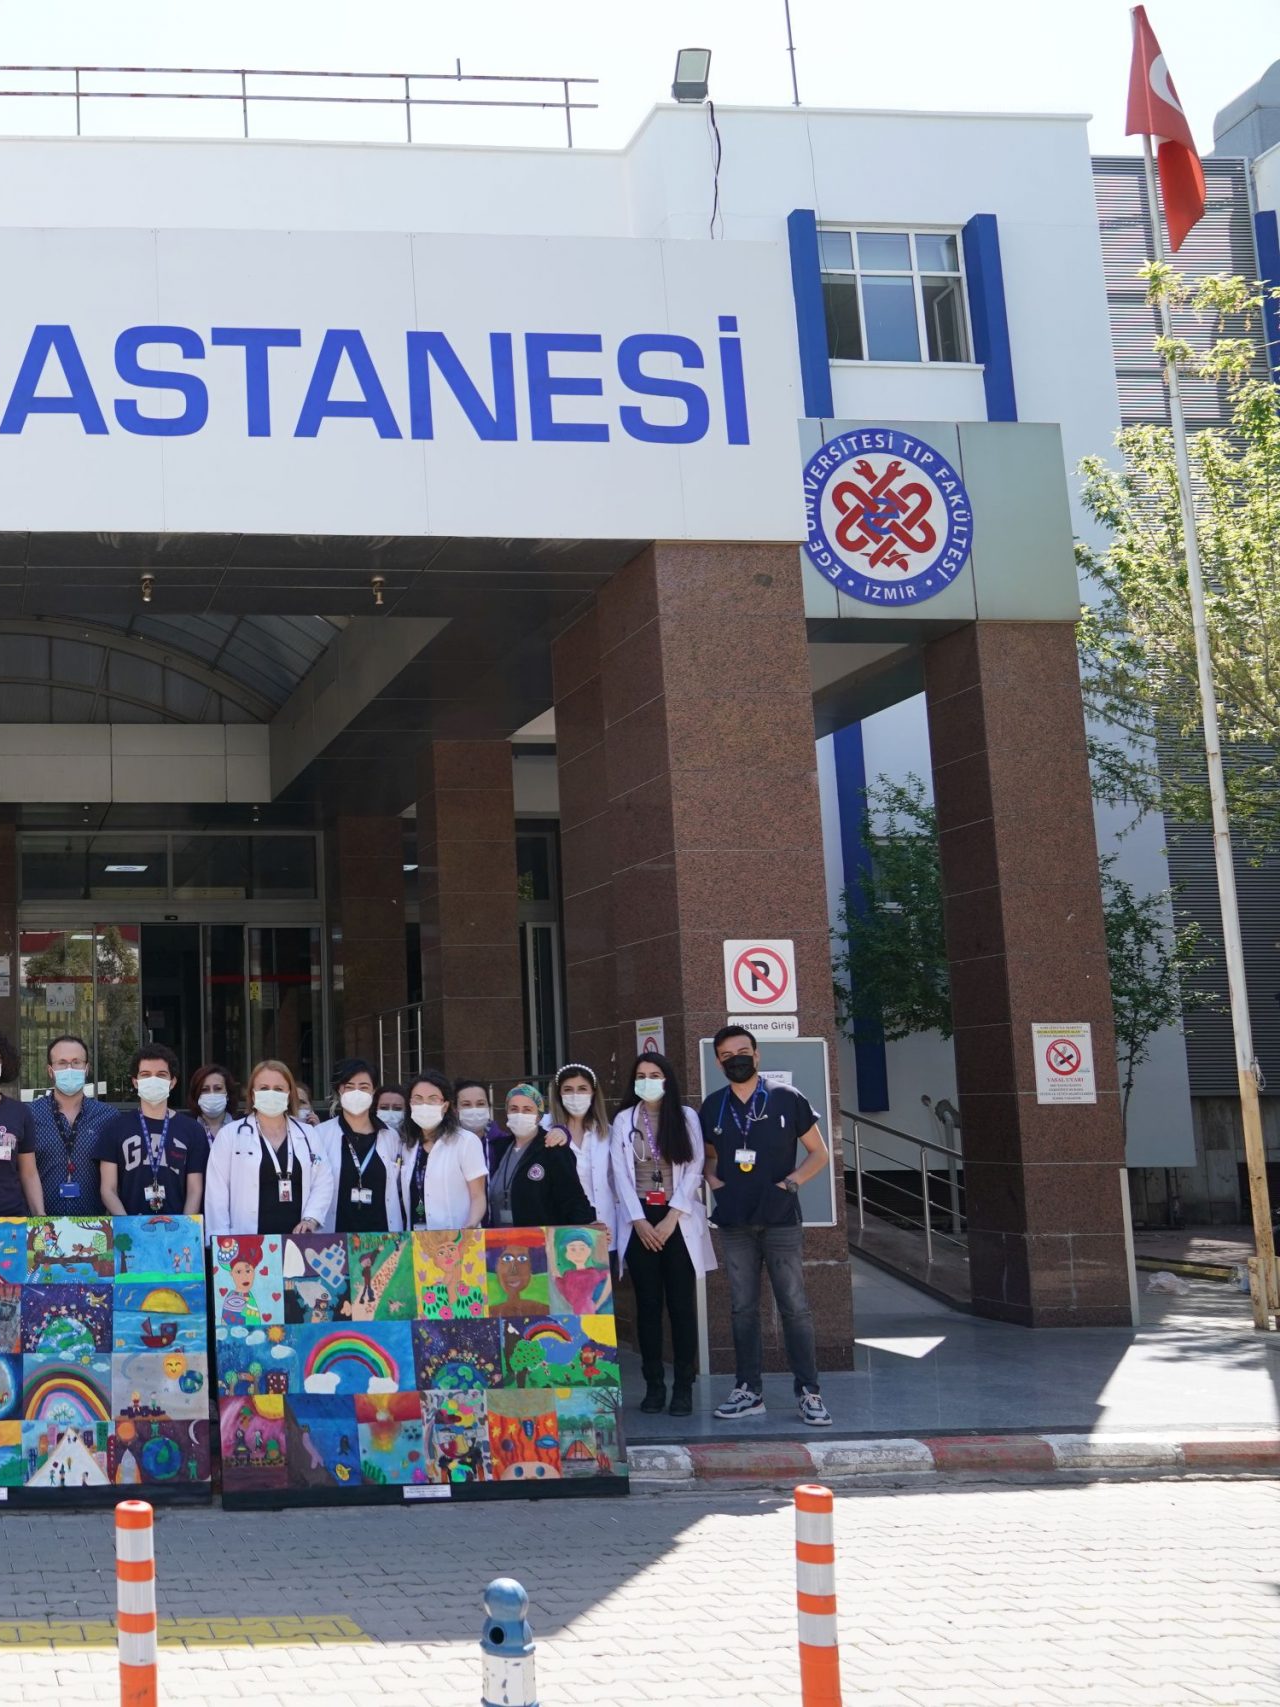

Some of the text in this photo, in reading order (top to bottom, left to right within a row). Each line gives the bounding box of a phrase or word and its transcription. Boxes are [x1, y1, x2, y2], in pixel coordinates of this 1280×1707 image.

[809, 540, 842, 580] EGE
[903, 439, 935, 464] TIP
[935, 467, 971, 582] FAKÜLTESİ
[864, 581, 918, 600] İZMİR
[770, 1021, 795, 1032] Girişi
